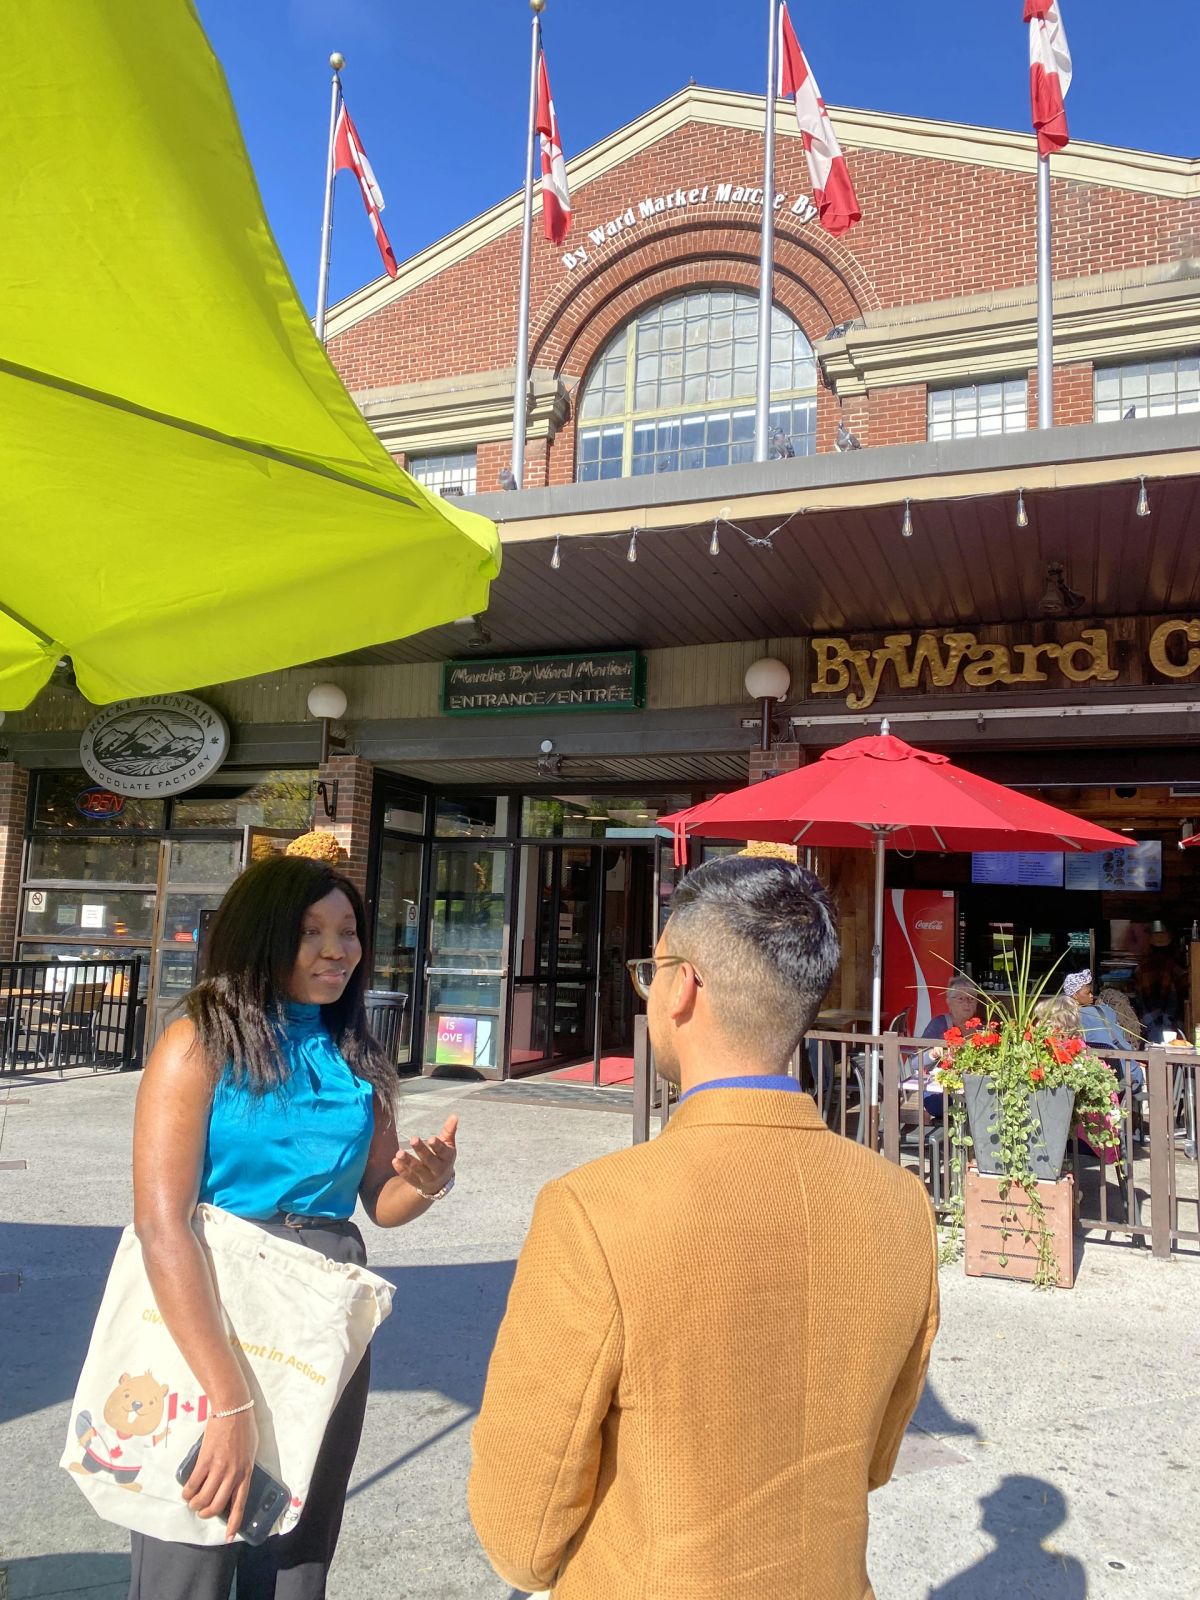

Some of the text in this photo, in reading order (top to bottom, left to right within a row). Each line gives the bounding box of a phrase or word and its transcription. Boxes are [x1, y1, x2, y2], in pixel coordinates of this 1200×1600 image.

[562, 183, 818, 270] By Ward Market Marcé By
[508, 665, 532, 685] By
[533, 662, 574, 680] Ward
[575, 660, 633, 678] Market
[811, 628, 1119, 710] ByWard
[139, 694, 216, 729] MOUNTAIN
[86, 754, 211, 790] CHOCOLATE FACTORY
[78, 793, 126, 811] OPEN
[437, 1032, 463, 1043] LOVE
[446, 1021, 455, 1031] IS
[142, 1309, 163, 1326] Civ
[268, 1346, 284, 1363] in
[285, 1355, 327, 1387] Action
